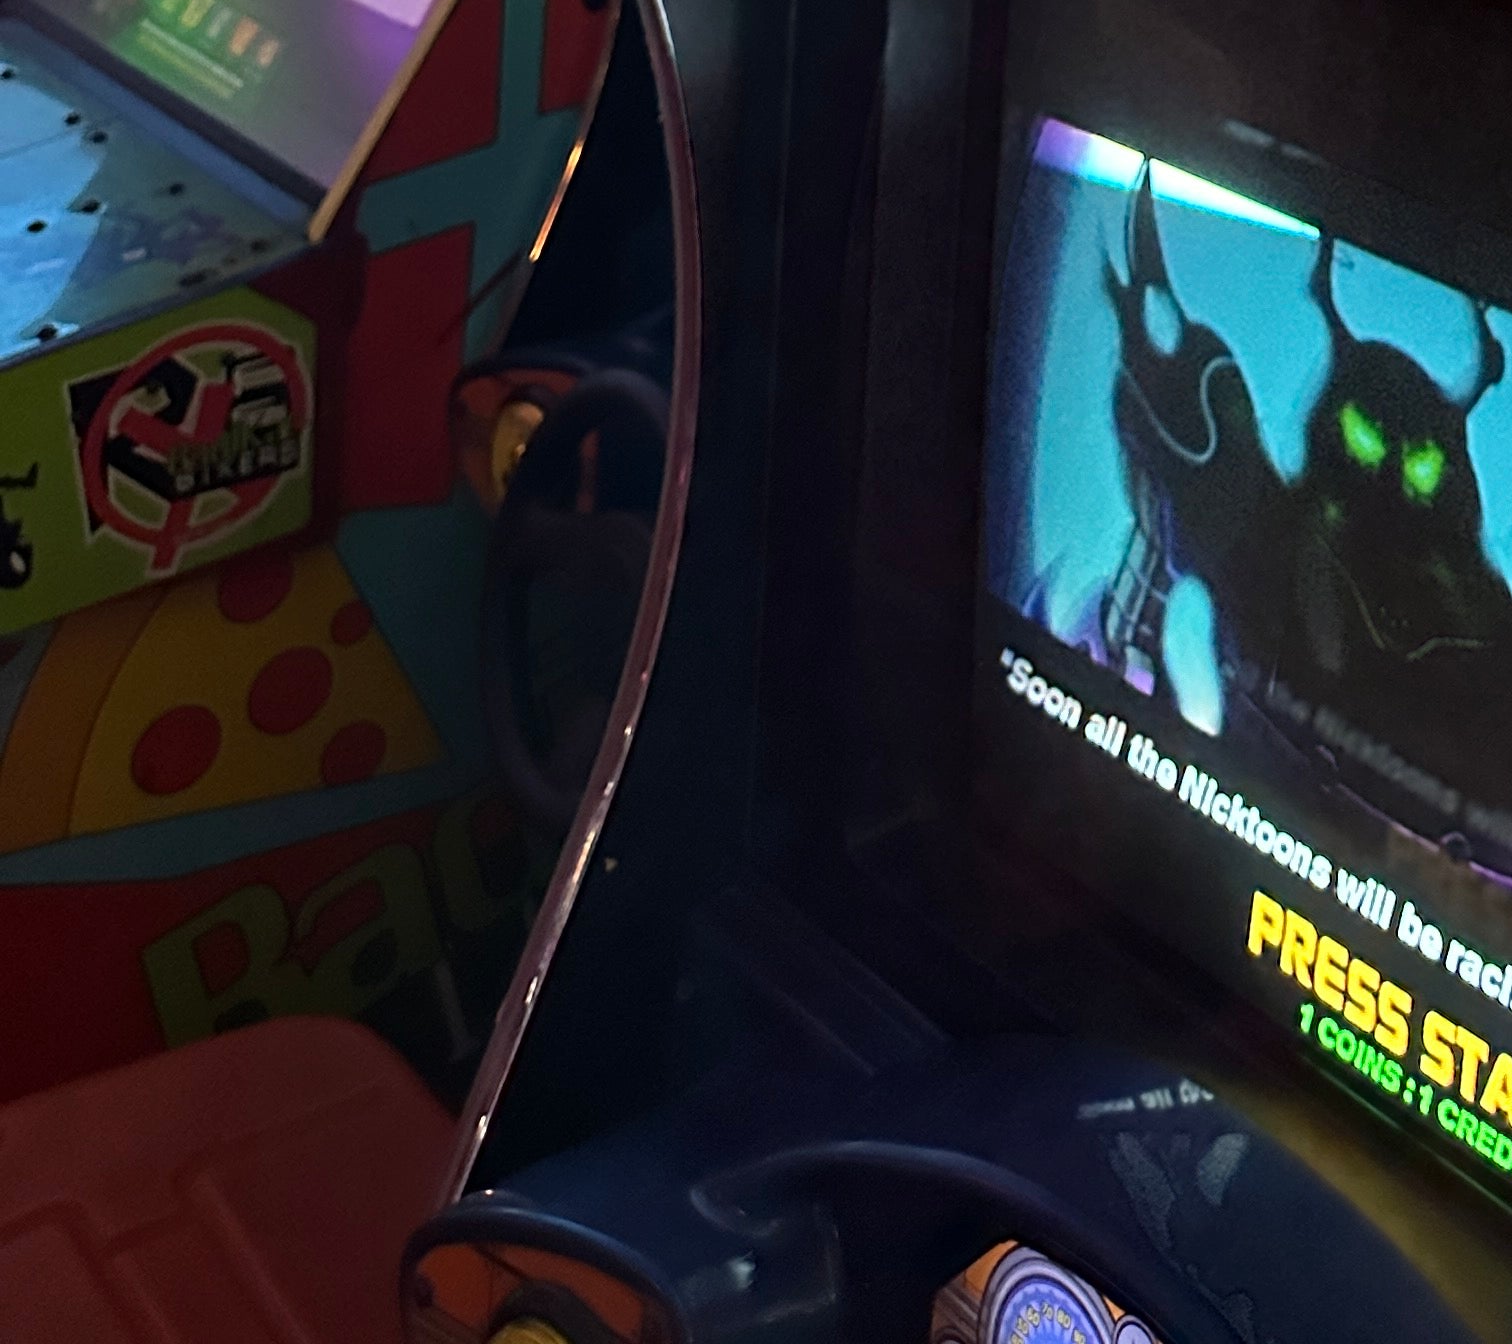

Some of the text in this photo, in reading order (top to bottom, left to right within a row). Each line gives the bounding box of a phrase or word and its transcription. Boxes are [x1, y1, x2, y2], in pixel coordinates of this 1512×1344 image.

[1084, 713, 1128, 758] all
[1126, 732, 1180, 792] the
[1178, 763, 1333, 891] Nicktoons
[1335, 867, 1397, 931] will
[1397, 901, 1444, 961] be
[1247, 889, 1414, 1057] PRESS
[1299, 1002, 1316, 1035] 1
[1316, 1016, 1405, 1094] COINS
